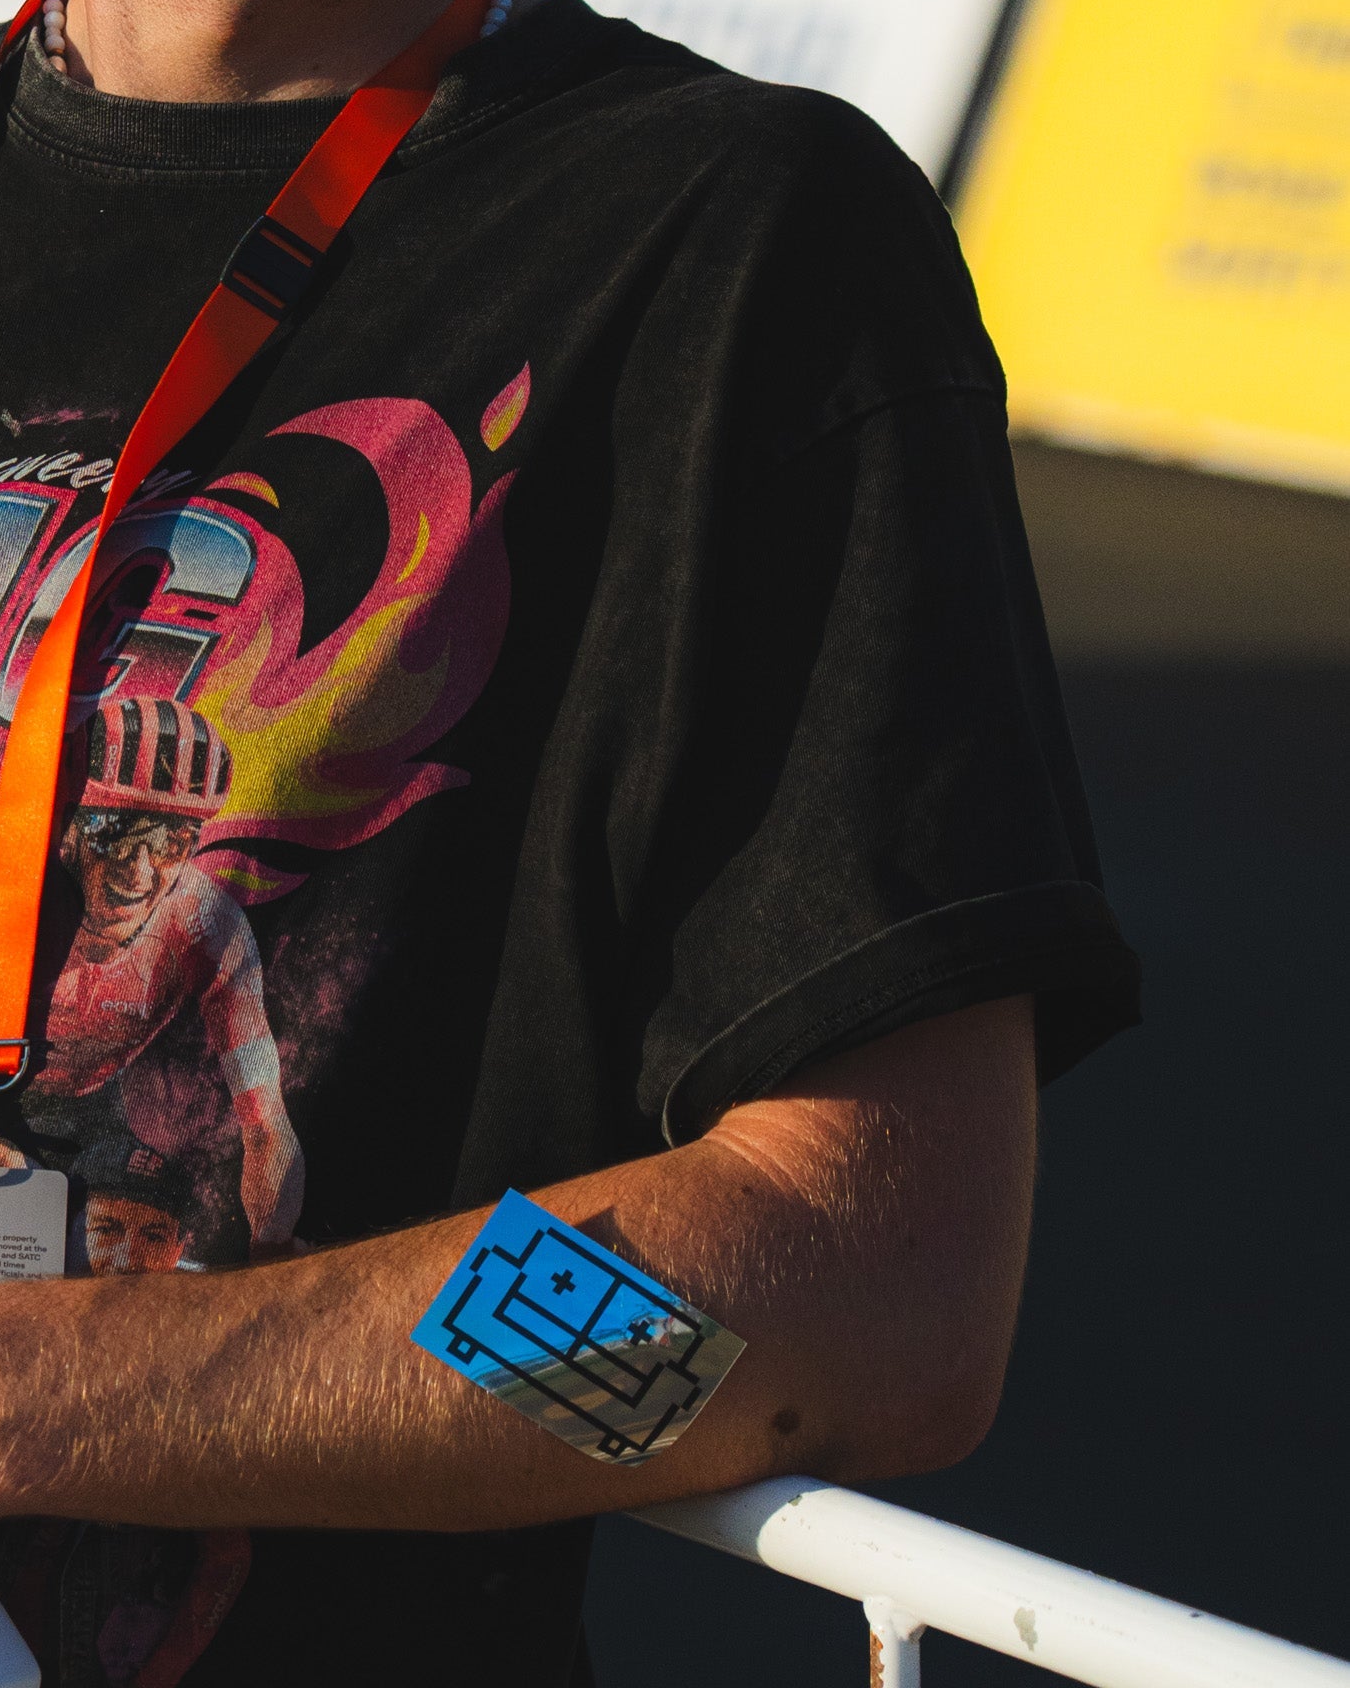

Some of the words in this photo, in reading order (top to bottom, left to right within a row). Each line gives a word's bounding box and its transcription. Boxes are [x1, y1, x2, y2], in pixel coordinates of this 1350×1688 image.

[3, 1234, 37, 1243] property
[34, 1245, 48, 1253] the
[1, 1251, 17, 1260] and
[18, 1252, 41, 1261] SATC
[3, 1260, 26, 1269] times
[25, 1272, 42, 1280] and
